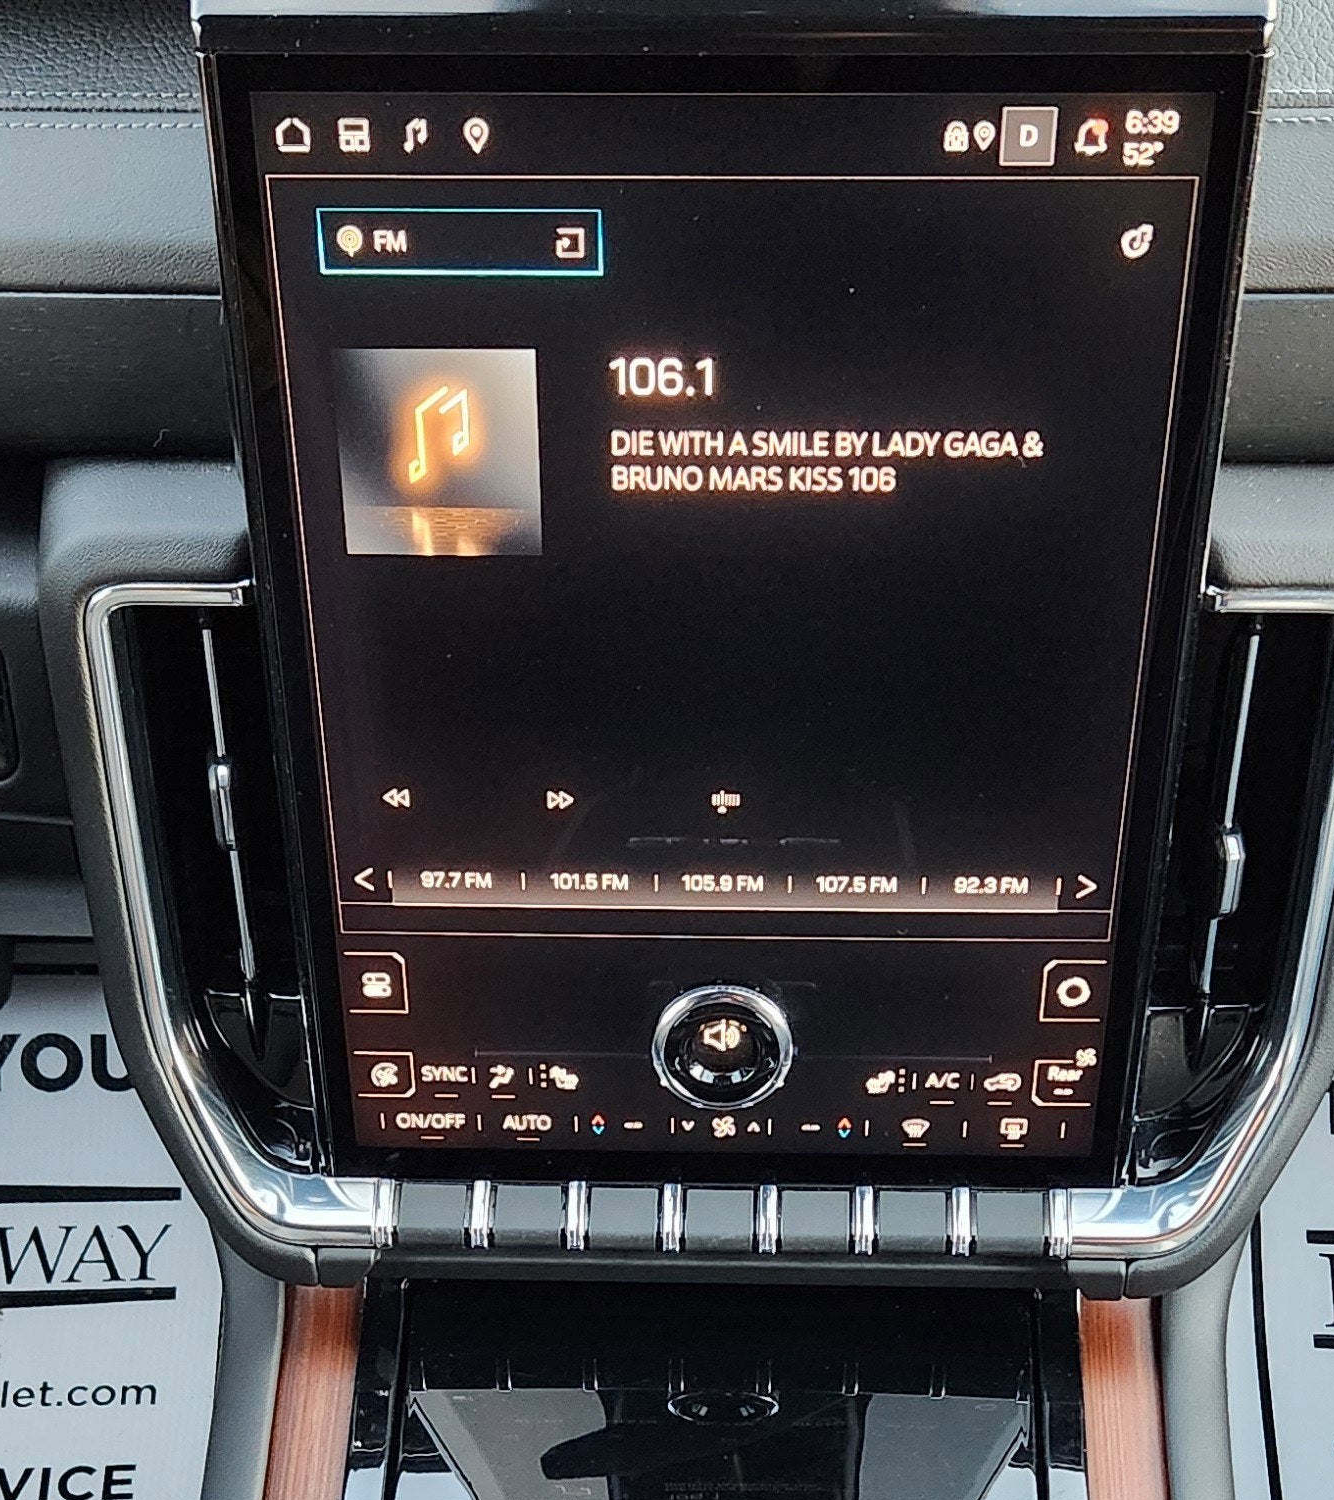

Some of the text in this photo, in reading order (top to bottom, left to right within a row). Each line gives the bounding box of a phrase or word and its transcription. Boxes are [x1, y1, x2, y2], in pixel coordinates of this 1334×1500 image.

[1124, 108, 1180, 135] 6:39
[1020, 124, 1038, 147] D
[1122, 141, 1164, 166] 52°
[373, 229, 407, 253] FM
[608, 356, 715, 397] 106.1
[610, 430, 1045, 458] DIE WITH A SMILE BY LADY GAGA &
[610, 465, 897, 492] BRUNO MARS KISS 106
[420, 871, 492, 889] 97.7 FM
[550, 873, 629, 891] 101.5 FM
[682, 874, 764, 892] 105.9 FM
[816, 876, 897, 893] 107.5 FM
[954, 876, 1028, 894] 92.3 FM
[420, 1065, 468, 1083] SYNC
[924, 1072, 960, 1090] A/C
[1047, 1065, 1083, 1082] Rear
[395, 1112, 466, 1130] ON/OFF
[502, 1114, 553, 1131] AUTO
